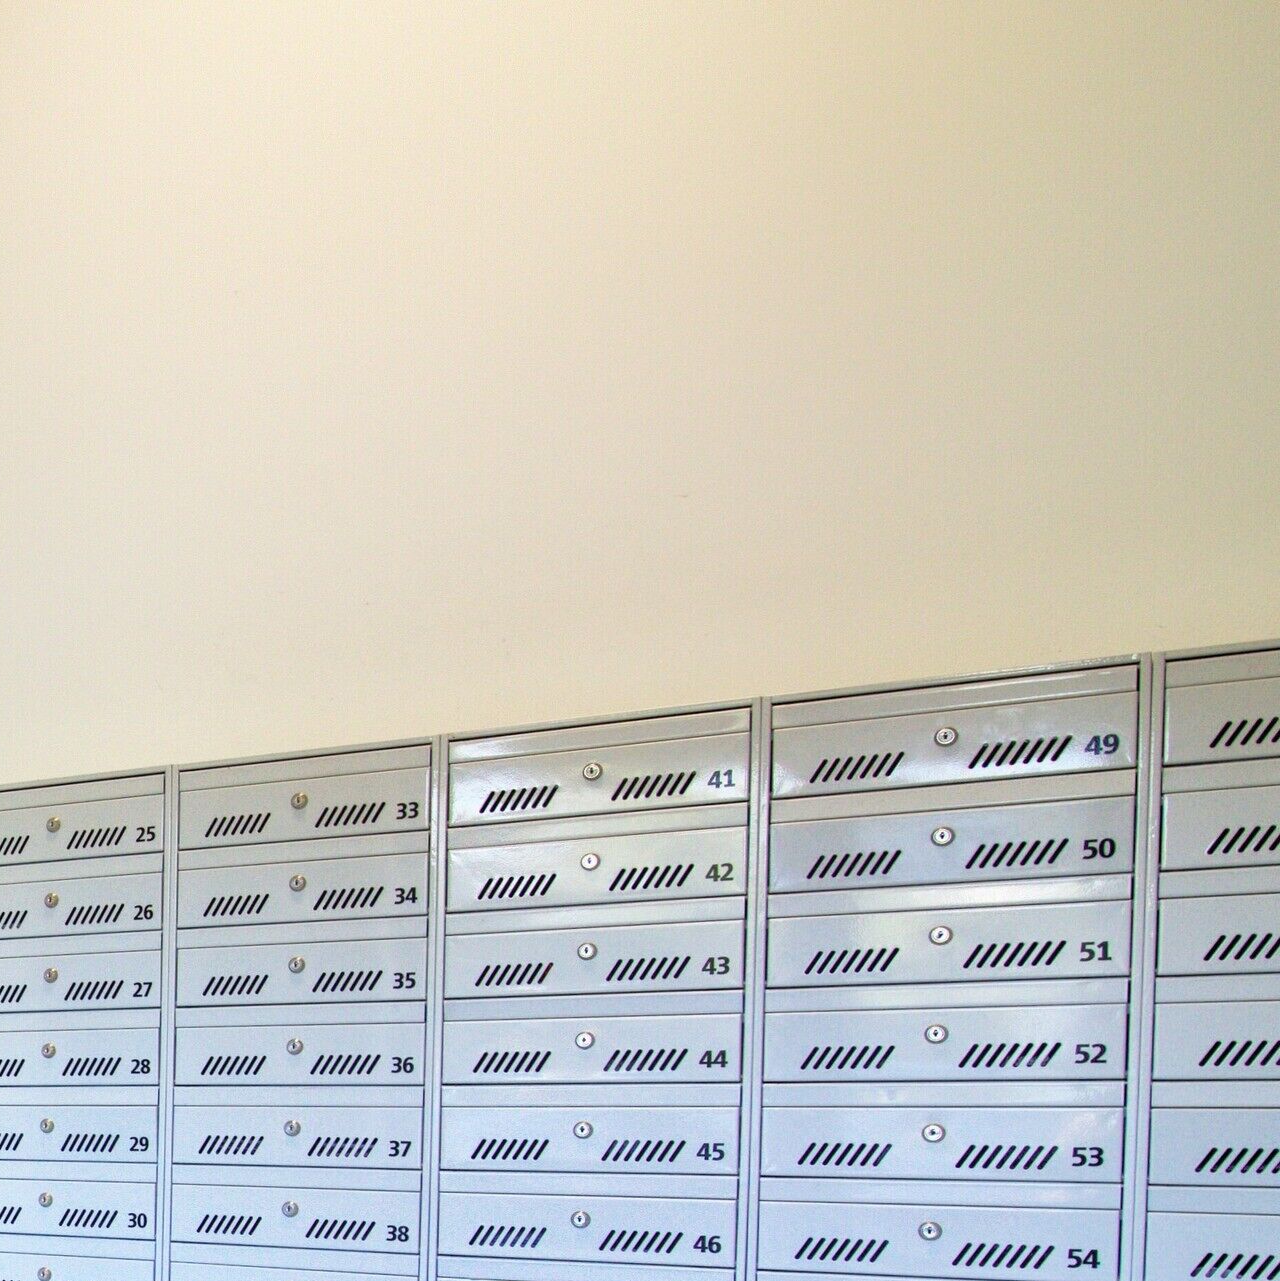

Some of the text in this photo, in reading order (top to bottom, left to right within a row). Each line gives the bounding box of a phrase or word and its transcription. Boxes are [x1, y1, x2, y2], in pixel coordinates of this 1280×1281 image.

[1084, 733, 1120, 756] 49
[707, 769, 736, 789] 41
[396, 801, 419, 820] 33
[135, 825, 156, 843] 25
[1082, 837, 1116, 860] 50
[705, 862, 734, 882] 42
[394, 886, 418, 905] 34
[133, 904, 154, 921] 26
[1079, 940, 1112, 962] 51
[701, 956, 730, 976] 43
[132, 981, 153, 998] 27
[392, 971, 416, 990] 35
[698, 1049, 729, 1068] 44
[1074, 1043, 1107, 1064] 52
[130, 1058, 151, 1075] 28
[390, 1056, 415, 1074] 36
[129, 1136, 149, 1152] 29
[388, 1140, 412, 1158] 37
[696, 1142, 725, 1161] 45
[1071, 1146, 1104, 1167] 53
[127, 1212, 148, 1229] 30
[386, 1224, 410, 1243] 38
[693, 1235, 722, 1254] 46
[1067, 1248, 1101, 1269] 54
